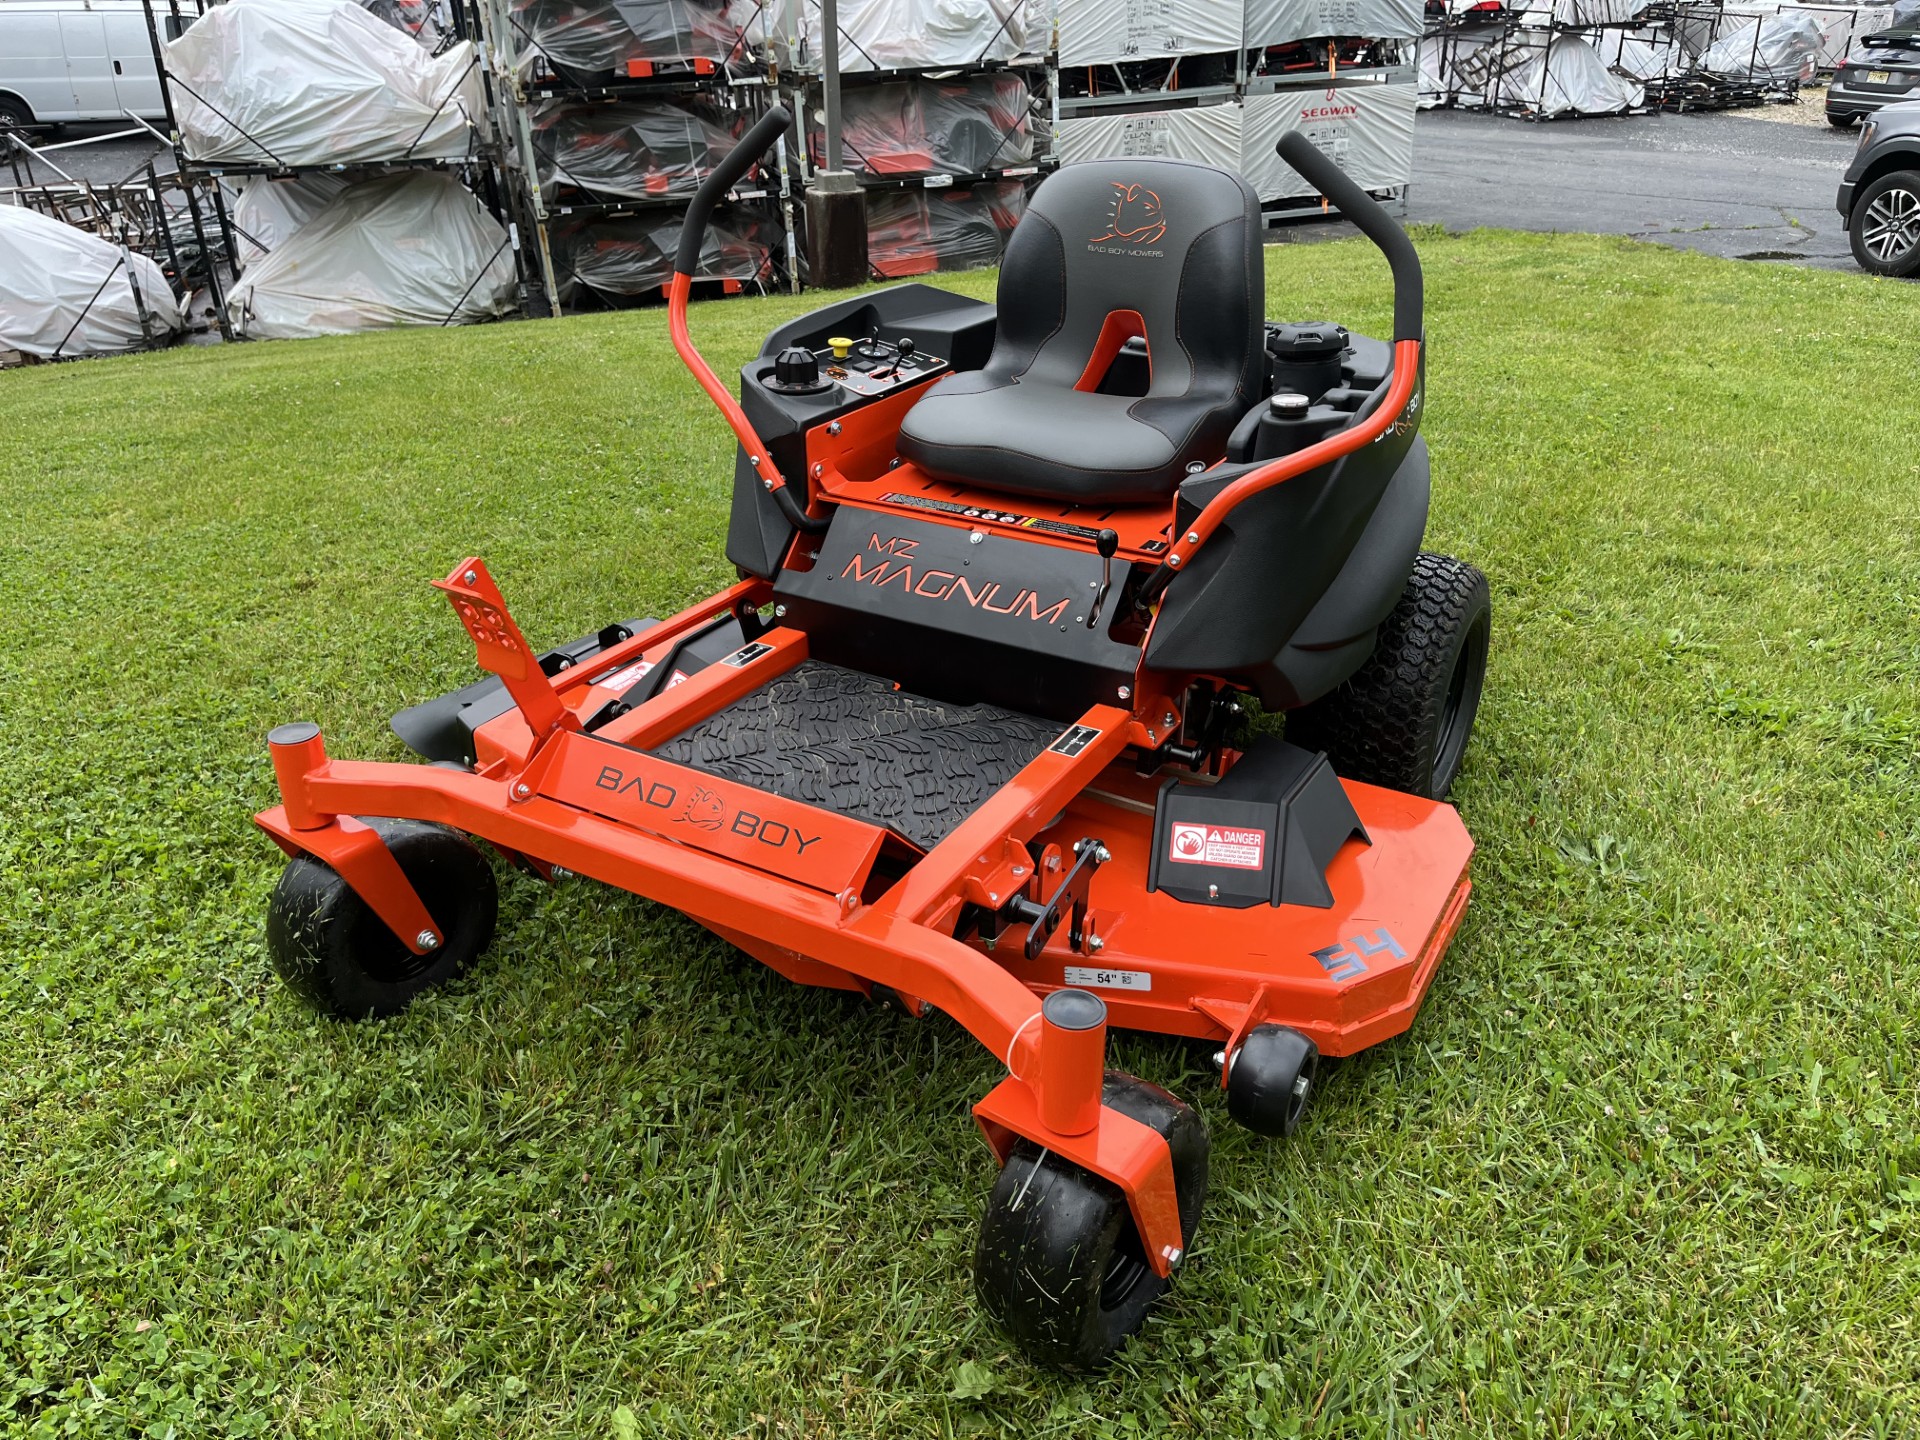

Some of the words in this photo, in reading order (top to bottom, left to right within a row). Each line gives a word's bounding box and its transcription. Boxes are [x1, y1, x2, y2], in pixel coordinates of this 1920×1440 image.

[1301, 105, 1358, 119] SEGWAY
[1087, 244, 1107, 253] BAD
[1108, 247, 1127, 255] BOY
[1128, 249, 1164, 258] MOWERS
[866, 531, 920, 560] MZ
[840, 552, 1072, 625] MAGNUM
[595, 765, 677, 809] BAD
[730, 810, 822, 856] BOY
[1224, 831, 1261, 845] DANGER
[1308, 927, 1408, 984] 54
[1097, 973, 1117, 984] 54"
